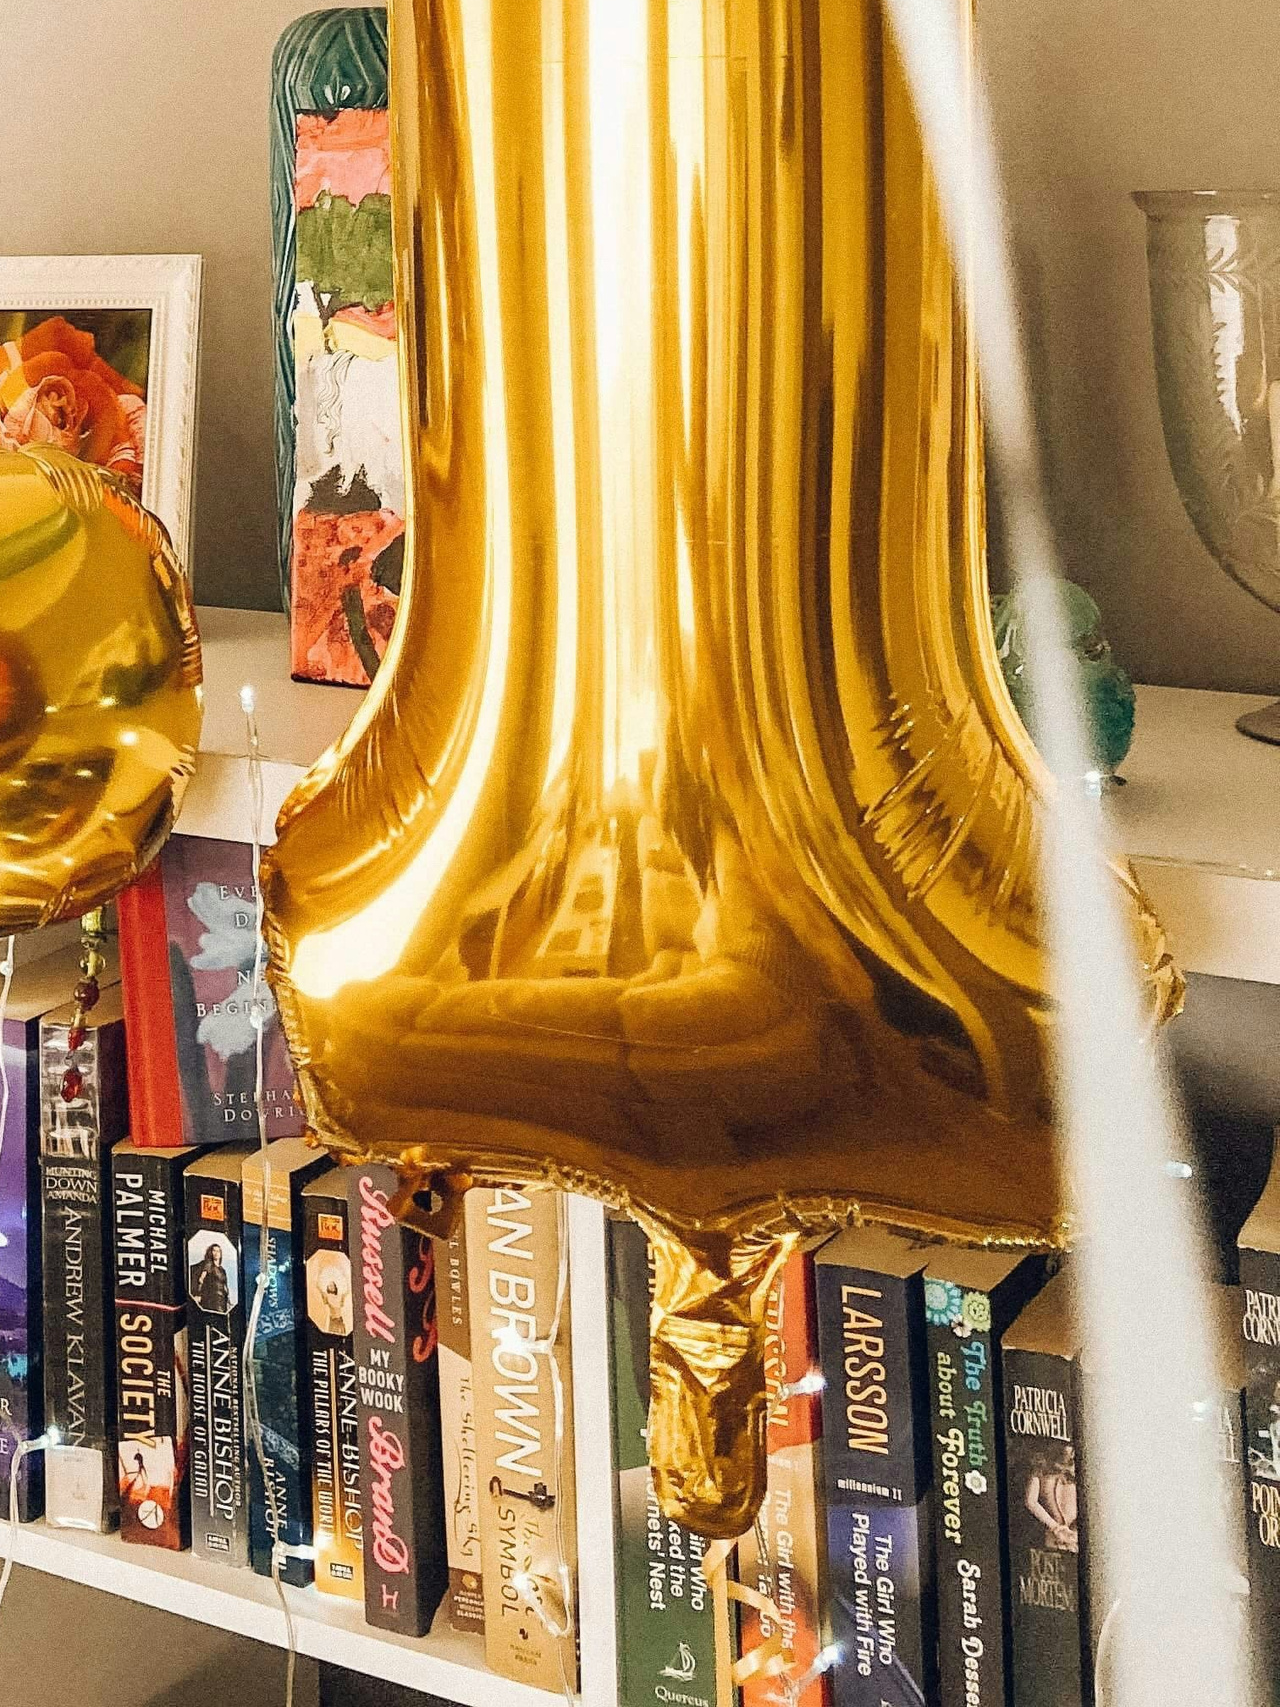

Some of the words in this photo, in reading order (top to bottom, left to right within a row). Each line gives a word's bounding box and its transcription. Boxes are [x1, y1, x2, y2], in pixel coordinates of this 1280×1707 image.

[220, 884, 260, 901] EVE
[45, 1177, 98, 1193] DOWN
[115, 1173, 146, 1287] PALMER
[148, 1189, 168, 1275] MICHAEL
[486, 1190, 536, 1262] AN
[64, 1205, 83, 1325] ANDREW
[266, 1236, 279, 1308] SHADOWS
[358, 1175, 397, 1344] Russell
[449, 1257, 463, 1326] BOWLES
[191, 1340, 206, 1369] THE
[211, 1325, 233, 1409] ANNE
[312, 1350, 327, 1376] THE
[358, 1366, 405, 1393] BOOKY
[369, 1347, 392, 1370] MY
[489, 1268, 542, 1481] BROWN
[841, 1284, 889, 1456] LARSSON
[962, 1341, 987, 1391] The
[65, 1331, 86, 1449] KLAVAN
[119, 1312, 157, 1450] SOCIETY
[157, 1369, 171, 1398] THE
[192, 1372, 207, 1422] HOUSE
[313, 1378, 330, 1434] PILLARS
[337, 1350, 358, 1434] ANNE
[360, 1388, 405, 1413] WOOK
[458, 1377, 472, 1402] The
[935, 1351, 958, 1419] about
[1013, 1384, 1067, 1417] PATRICIA
[193, 1426, 208, 1446] OF
[963, 1401, 988, 1467] Truth
[1010, 1408, 1071, 1443] CORNWELL
[213, 1416, 235, 1521] BISHOP
[316, 1461, 332, 1486] THE
[455, 1412, 477, 1515] Sheltering
[936, 1427, 965, 1545] Forever
[274, 1472, 287, 1532] ANNE
[342, 1442, 365, 1550] BISHOP
[775, 1488, 792, 1525] The
[497, 1505, 520, 1618] SYMBOL
[776, 1530, 795, 1569] Girl
[850, 1512, 871, 1584] Played
[874, 1533, 893, 1573] The
[648, 1561, 667, 1611] Nest
[668, 1565, 686, 1598] the
[689, 1566, 708, 1611] Who
[777, 1572, 796, 1614] with
[875, 1576, 895, 1614] Girl
[956, 1558, 983, 1629] Sarah
[853, 1588, 872, 1632] with
[855, 1635, 874, 1677] Fire
[876, 1618, 896, 1666] Who
[960, 1637, 985, 1707] Desse
